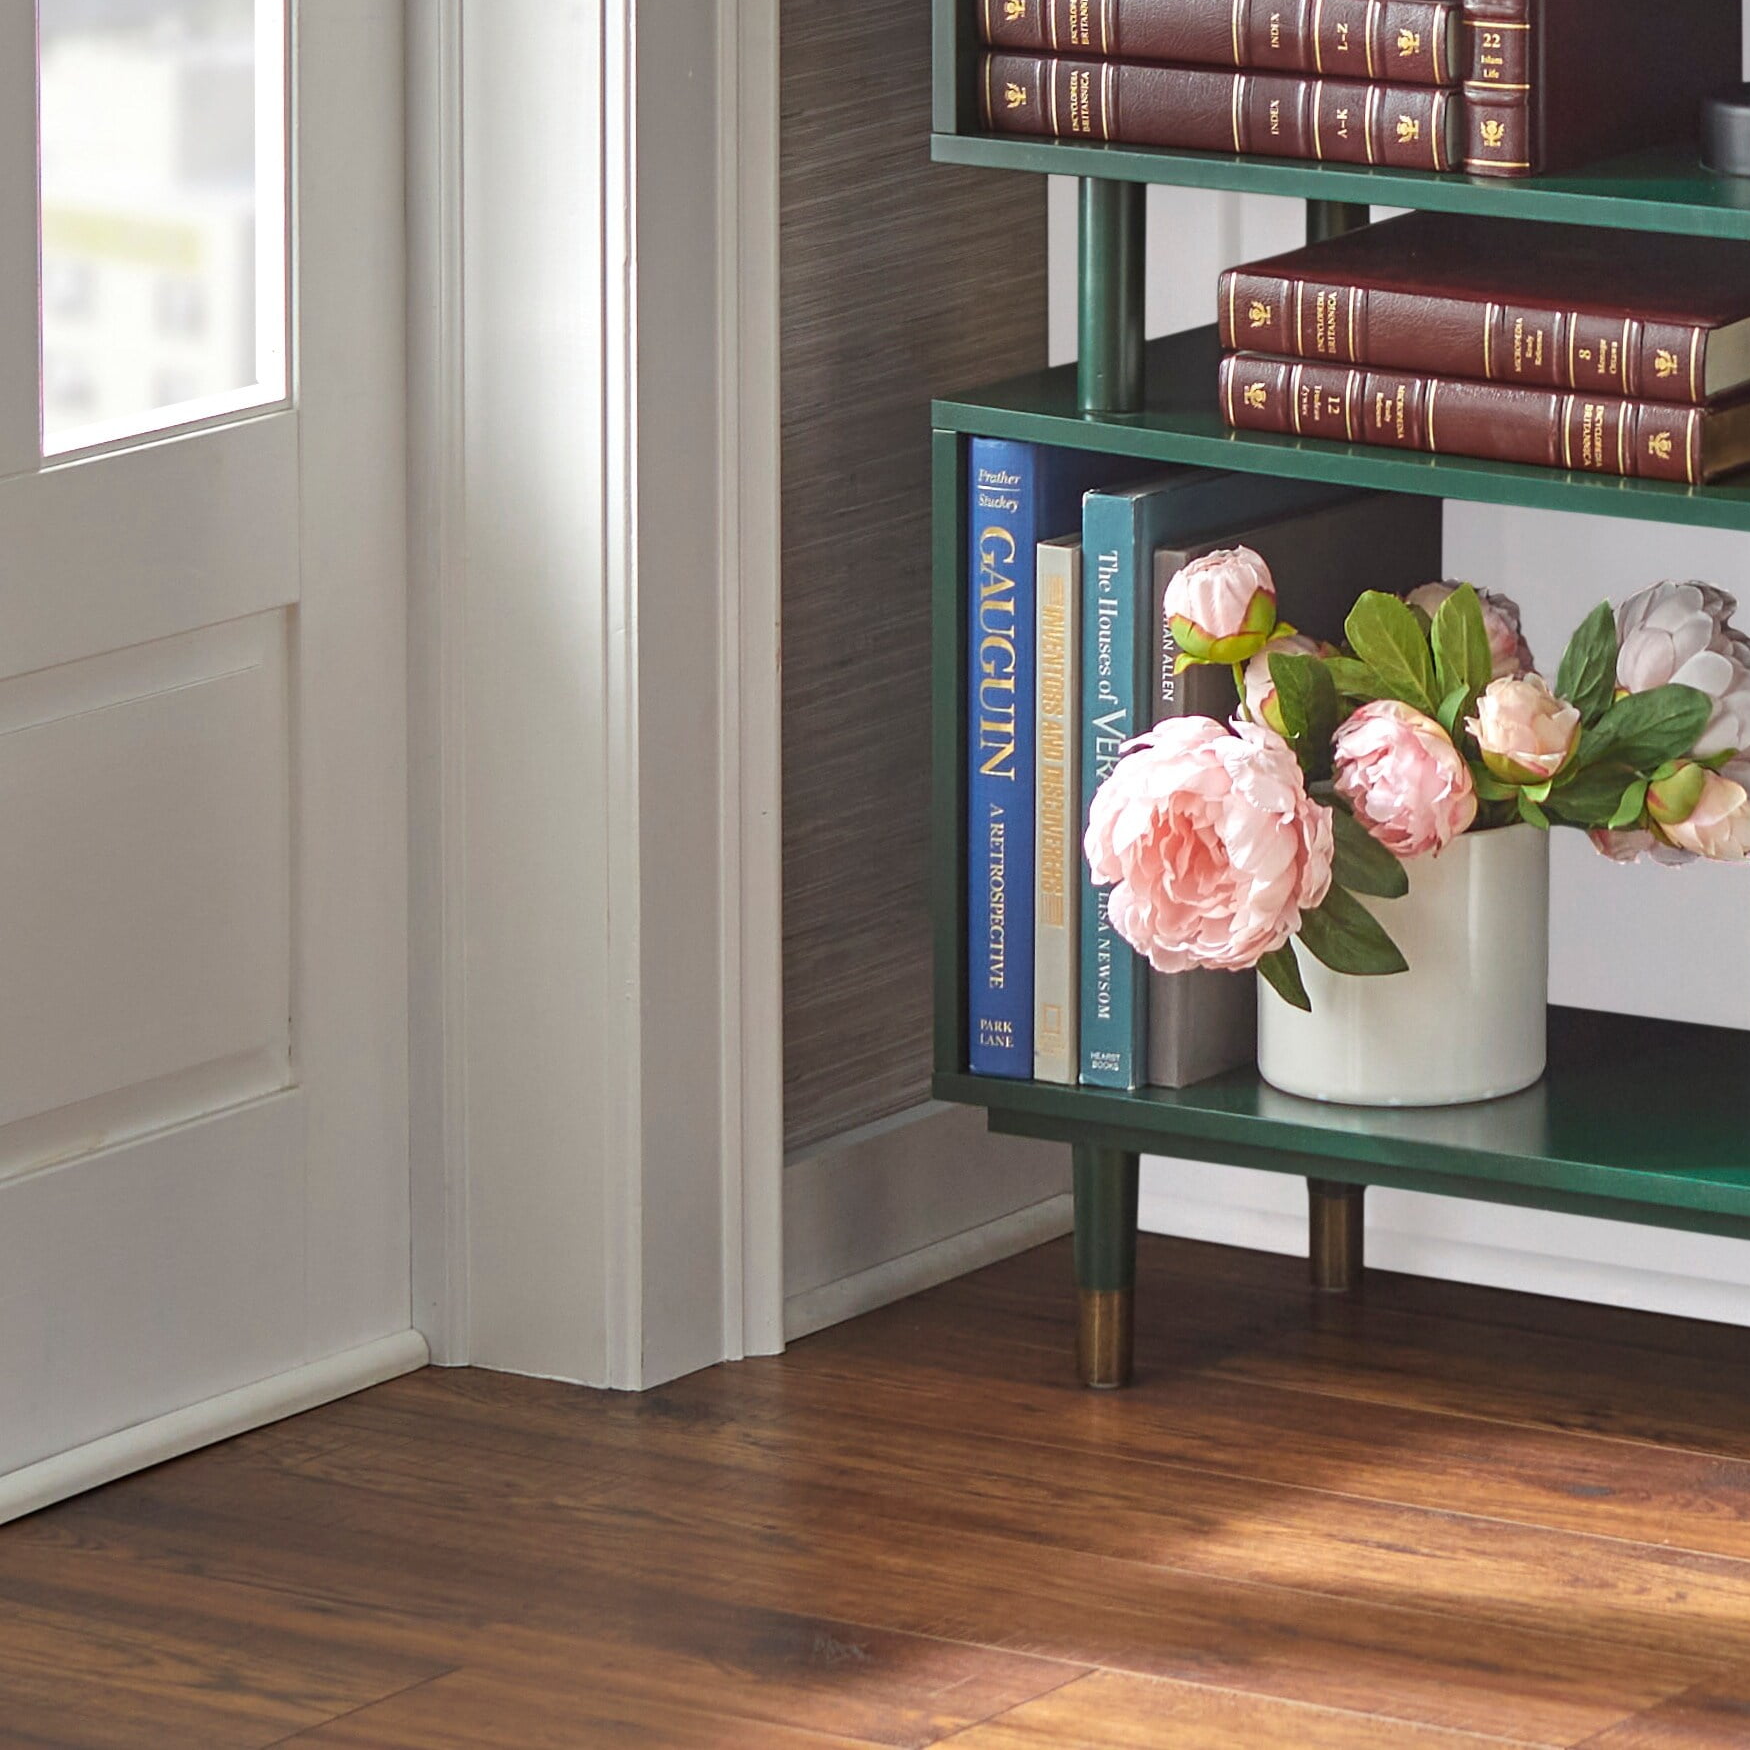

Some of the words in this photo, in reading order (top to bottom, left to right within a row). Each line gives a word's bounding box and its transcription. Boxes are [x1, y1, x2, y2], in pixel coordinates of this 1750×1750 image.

[1270, 12, 1280, 49] INDEX
[1482, 33, 1501, 48] 22
[1480, 55, 1503, 65] Islam
[1483, 69, 1500, 79] Life
[1080, 71, 1091, 133] BRITANNICA
[1270, 99, 1280, 135] INDEX
[1327, 291, 1338, 354] BRITANNICA
[1579, 349, 1592, 360] 8
[1328, 397, 1341, 414] 12
[1583, 404, 1594, 466] BRITANNICA
[978, 468, 1021, 485] Prather
[1098, 550, 1119, 593] The
[979, 526, 1016, 781] GAUGUIN
[1098, 599, 1118, 676] Houses
[1042, 605, 1065, 718] INVENTORS
[1162, 654, 1174, 702] ALLEN
[1098, 680, 1119, 705] of
[1042, 719, 1065, 762] AND
[989, 803, 1005, 819] A
[989, 823, 1005, 990] RETROSPECTIVE
[1098, 891, 1110, 933] LISA
[1097, 939, 1111, 1020] NEWSOM
[980, 1019, 1012, 1033] PARK
[980, 1033, 1014, 1048] LANE
[1091, 1061, 1120, 1071] BOOKS
